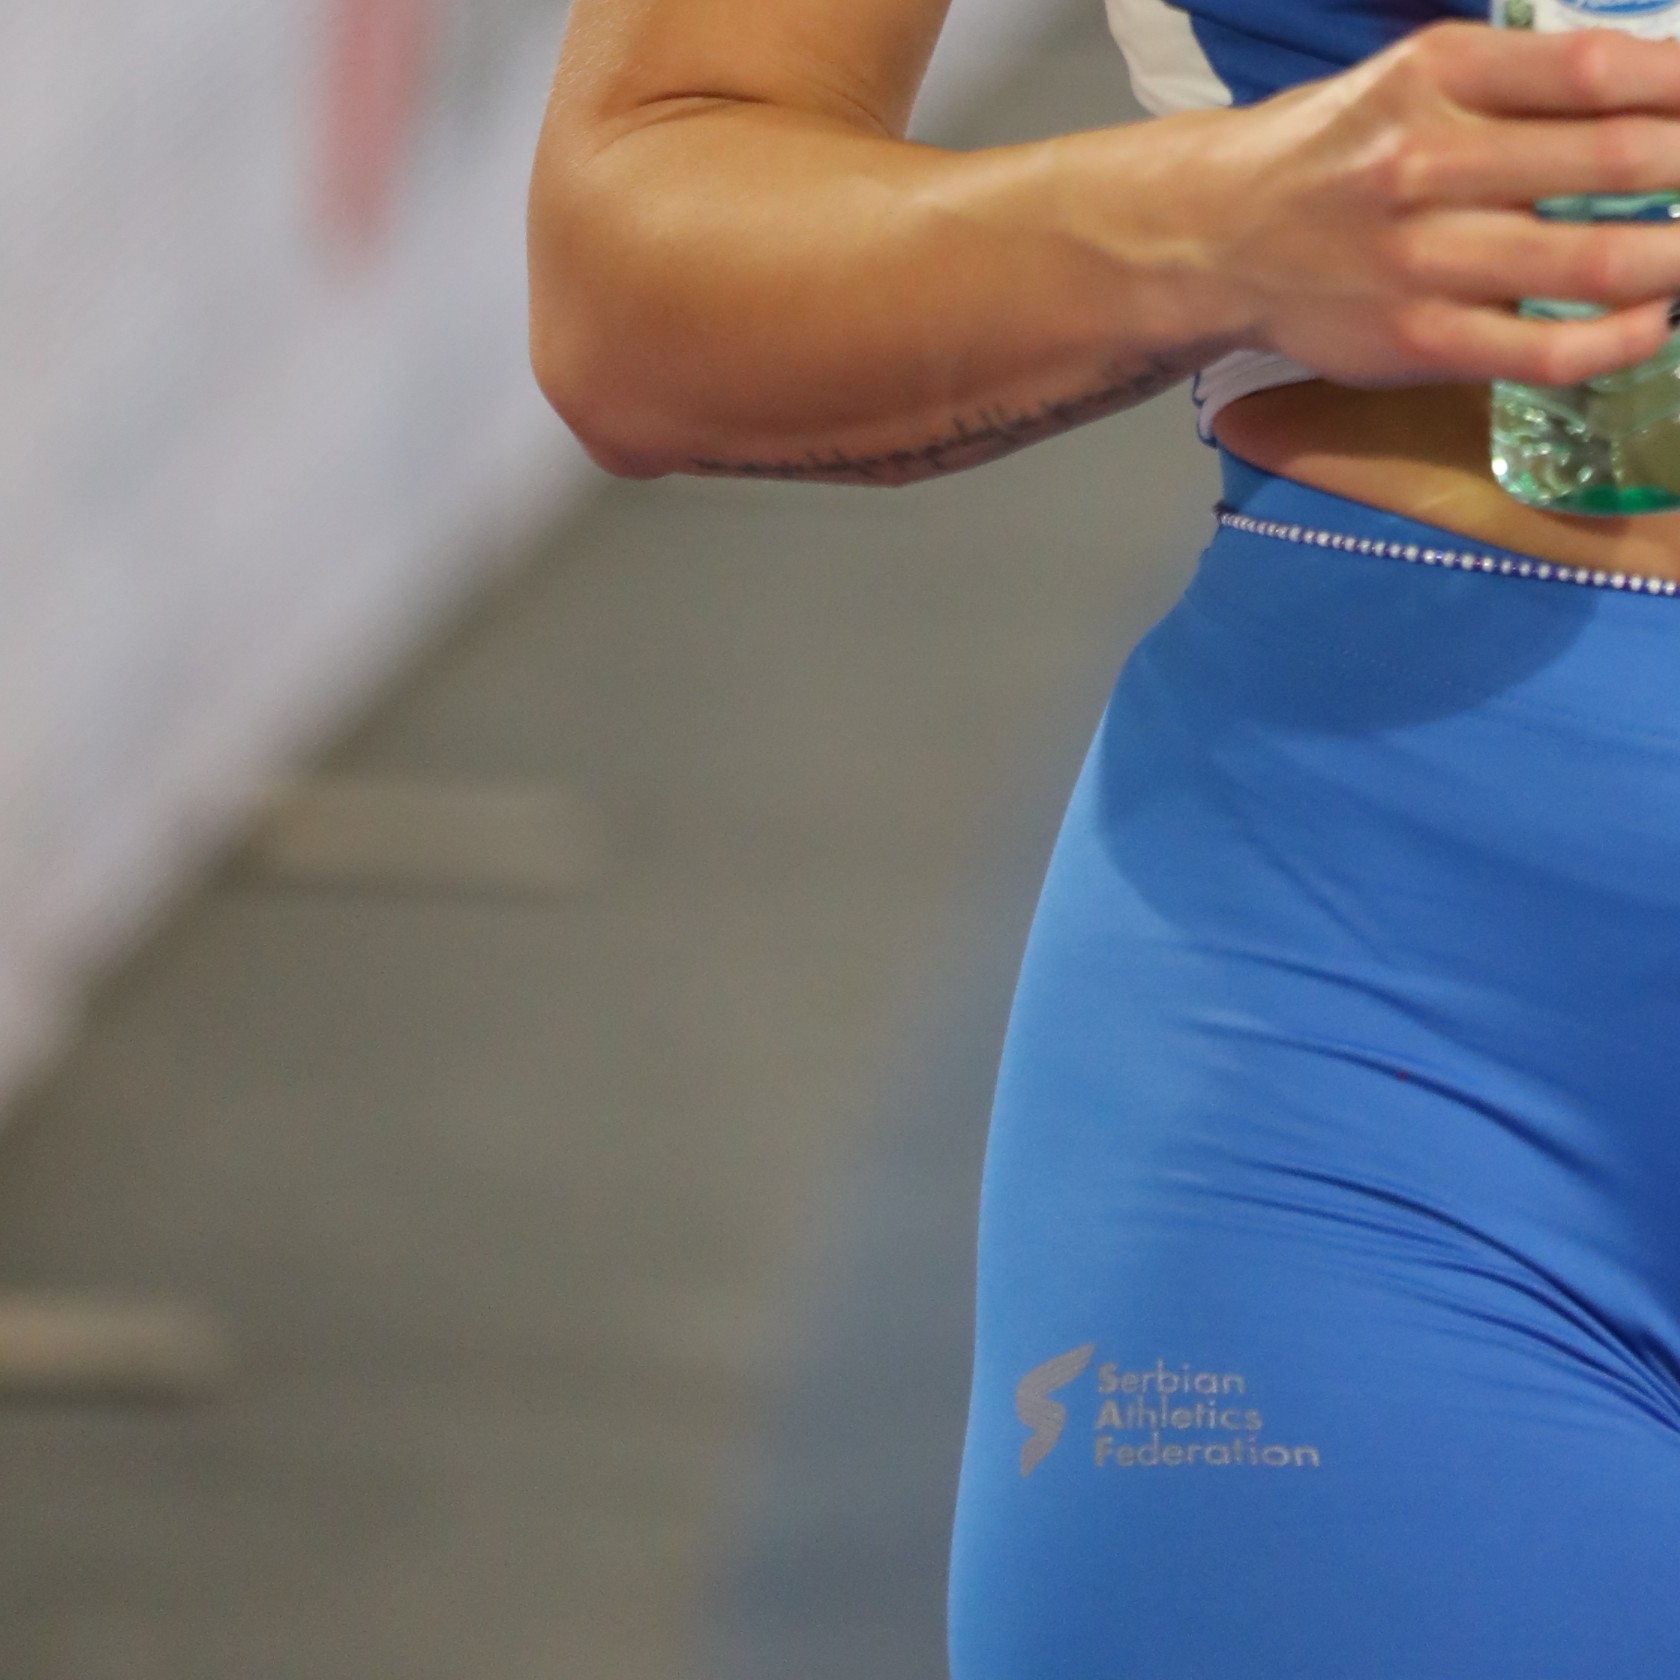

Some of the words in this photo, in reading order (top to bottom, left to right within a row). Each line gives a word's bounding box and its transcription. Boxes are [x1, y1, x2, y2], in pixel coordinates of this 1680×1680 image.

[1097, 1358, 1245, 1394] Serbian
[1095, 1394, 1262, 1431] Athletics
[1094, 1431, 1321, 1468] Federation
